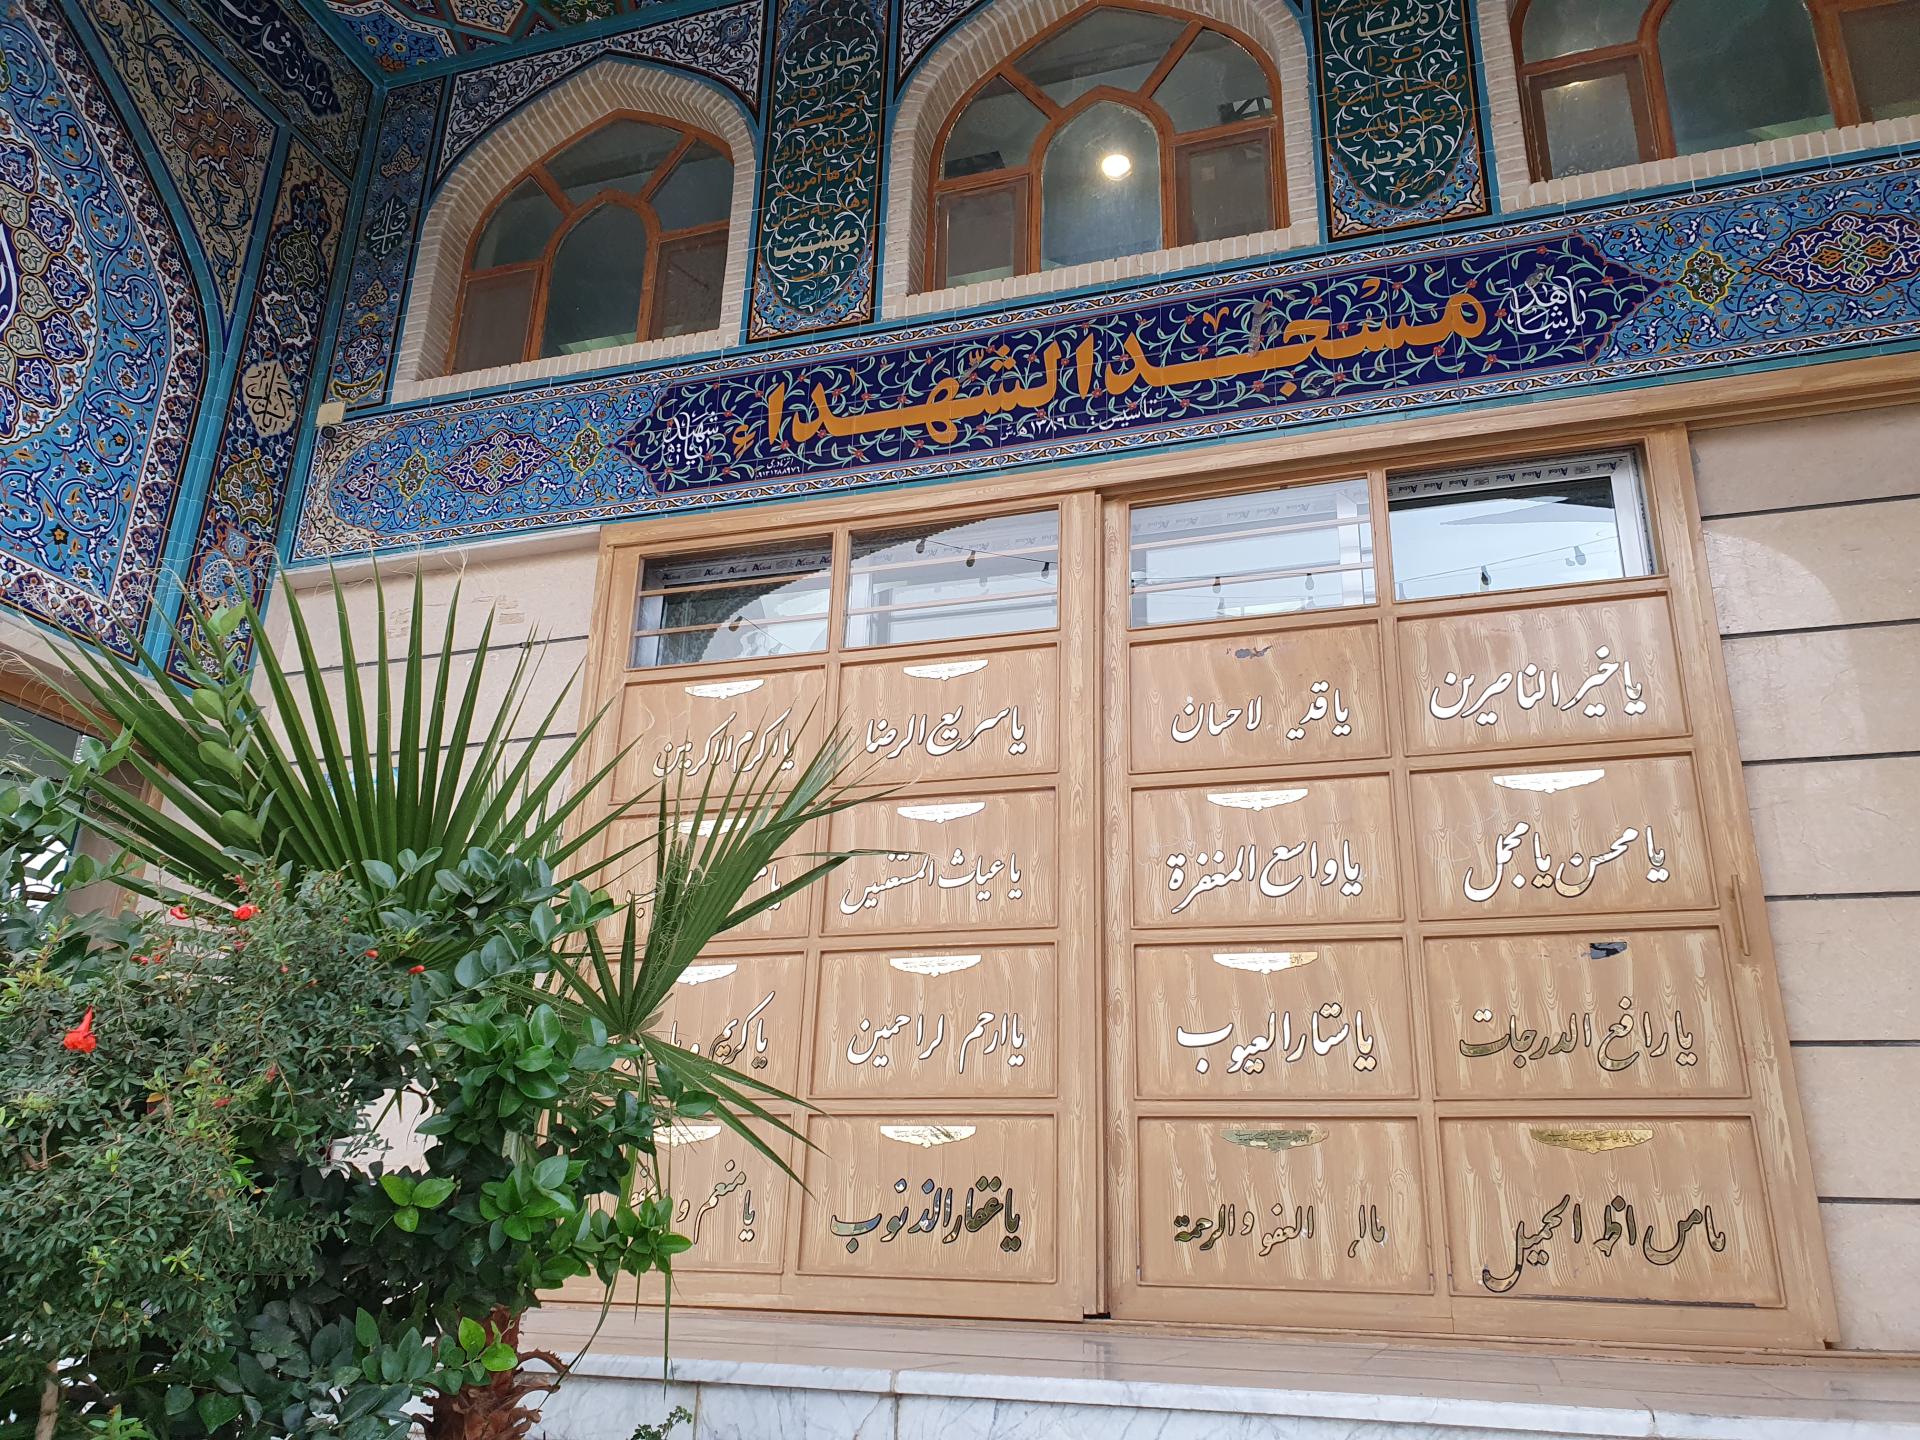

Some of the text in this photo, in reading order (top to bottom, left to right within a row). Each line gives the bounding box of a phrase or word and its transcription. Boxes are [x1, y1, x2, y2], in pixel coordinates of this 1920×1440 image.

[773, 223, 861, 258] بهشت
[1104, 277, 1488, 397] مسجد
[1331, 688, 1353, 738] یا
[1429, 644, 1647, 727] یا خیر الناصرین
[779, 728, 795, 771] یا
[864, 704, 1028, 760] یا سریع الرضا
[1007, 852, 1023, 900] یا
[1259, 840, 1339, 898] واسع
[1339, 839, 1364, 897] یا
[1530, 831, 1555, 889] یا
[1553, 826, 1639, 898] محسن
[1645, 825, 1670, 883] یا
[751, 1017, 769, 1069] یا
[958, 1011, 1008, 1075] ارحم
[1007, 1012, 1026, 1068] یا
[1176, 1002, 1378, 1075] یا ستار العیوب
[1460, 995, 1699, 1072] یا رافع الدرجات
[693, 1159, 747, 1245] منعم
[738, 1188, 756, 1242] یا
[830, 1177, 953, 1254] الذنوب
[1000, 1187, 1021, 1253] یا
